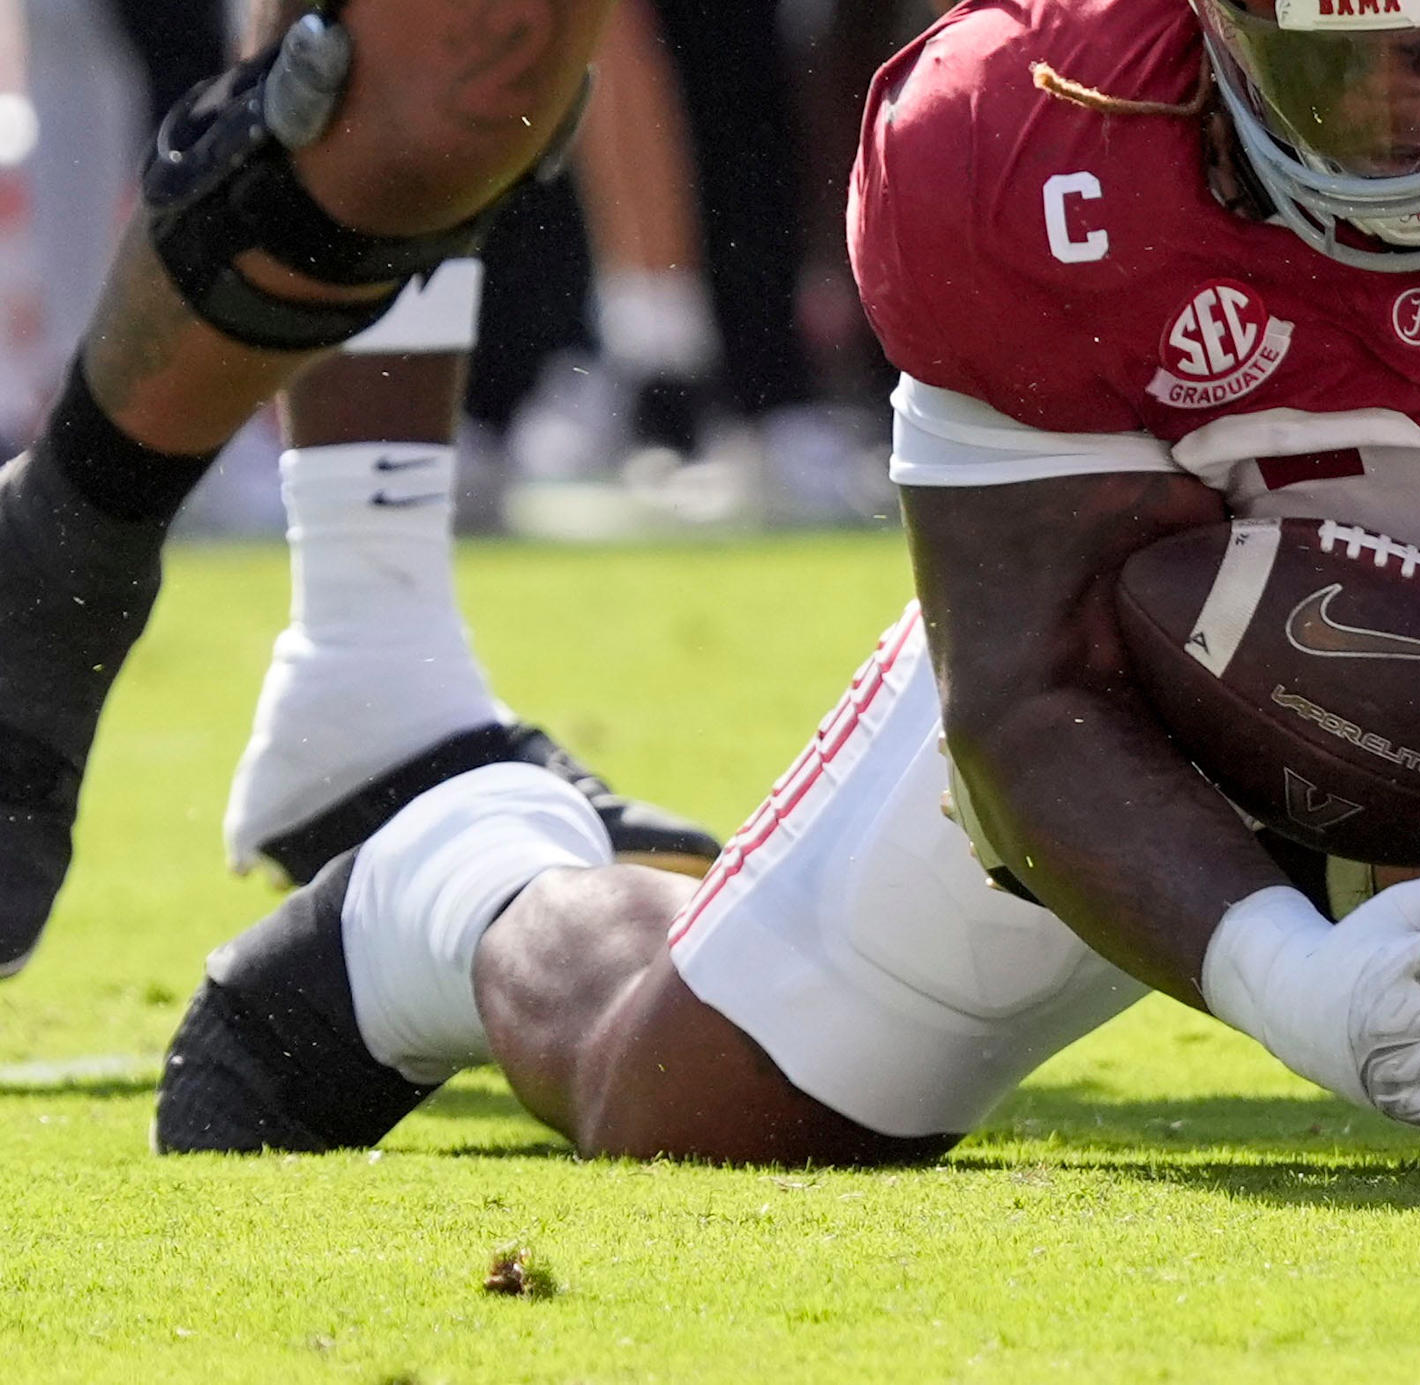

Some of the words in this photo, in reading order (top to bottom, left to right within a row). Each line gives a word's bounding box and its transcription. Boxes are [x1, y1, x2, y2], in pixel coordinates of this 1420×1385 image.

[1041, 171, 1109, 265] C
[1168, 285, 1258, 376] SEC
[1168, 345, 1280, 404] GRADUATE
